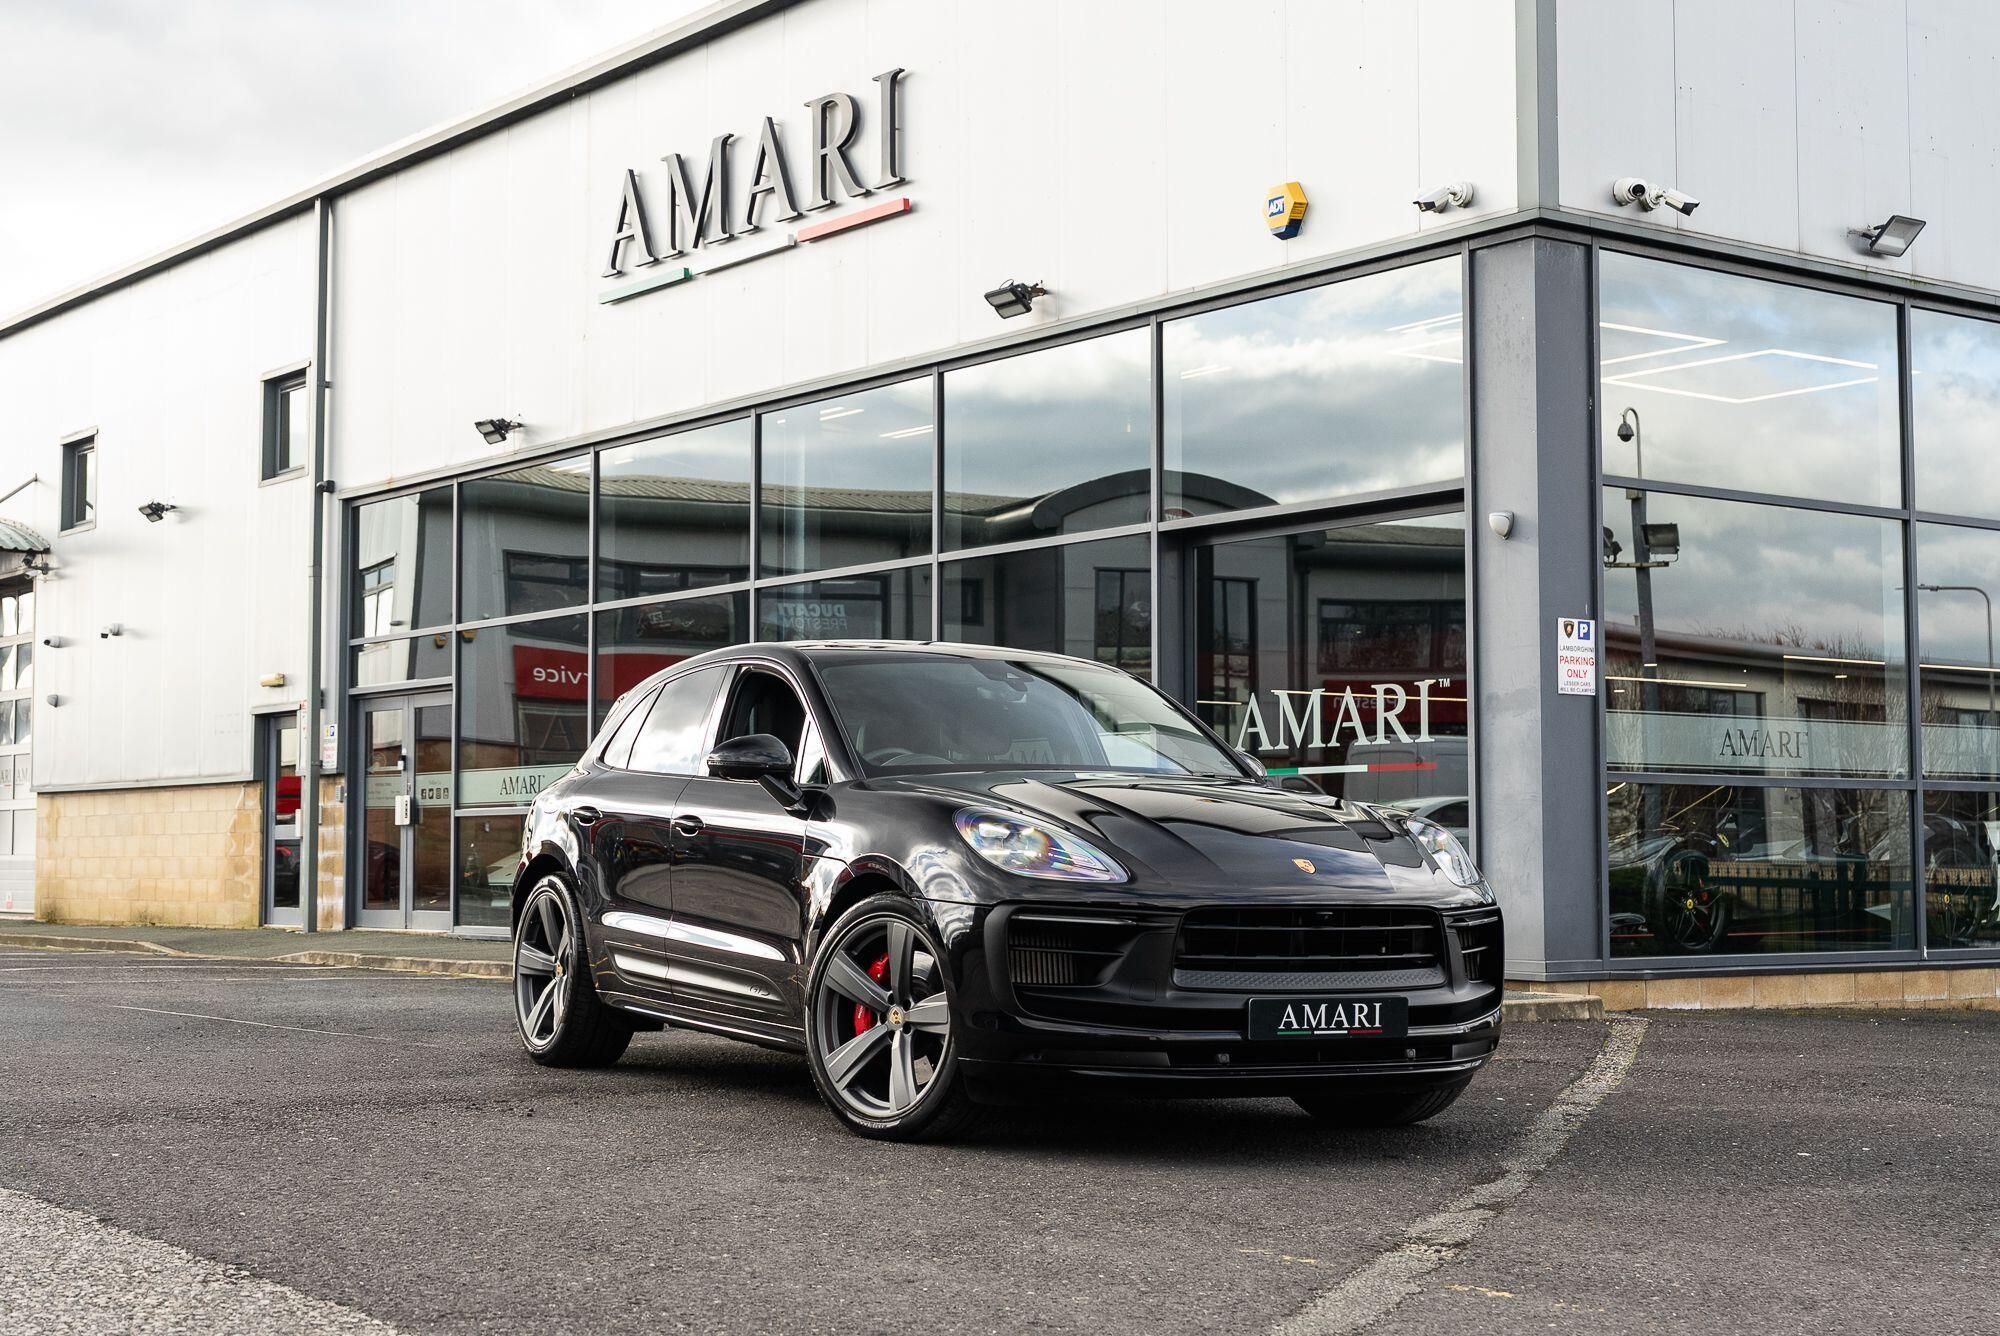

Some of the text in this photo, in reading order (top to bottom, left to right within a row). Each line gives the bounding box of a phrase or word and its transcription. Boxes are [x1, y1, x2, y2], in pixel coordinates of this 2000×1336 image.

[601, 67, 906, 278] AMARI
[1268, 197, 1285, 216] ADT
[1579, 623, 1588, 638] P
[1559, 645, 1595, 653] LAMBORGHINI
[1559, 656, 1595, 666] PARKING
[1567, 668, 1588, 679] ONLY
[1235, 679, 1437, 751] AMARI
[1719, 728, 1804, 759] AMARI
[499, 774, 542, 796] AMARI
[1277, 1002, 1383, 1029] AMARI
